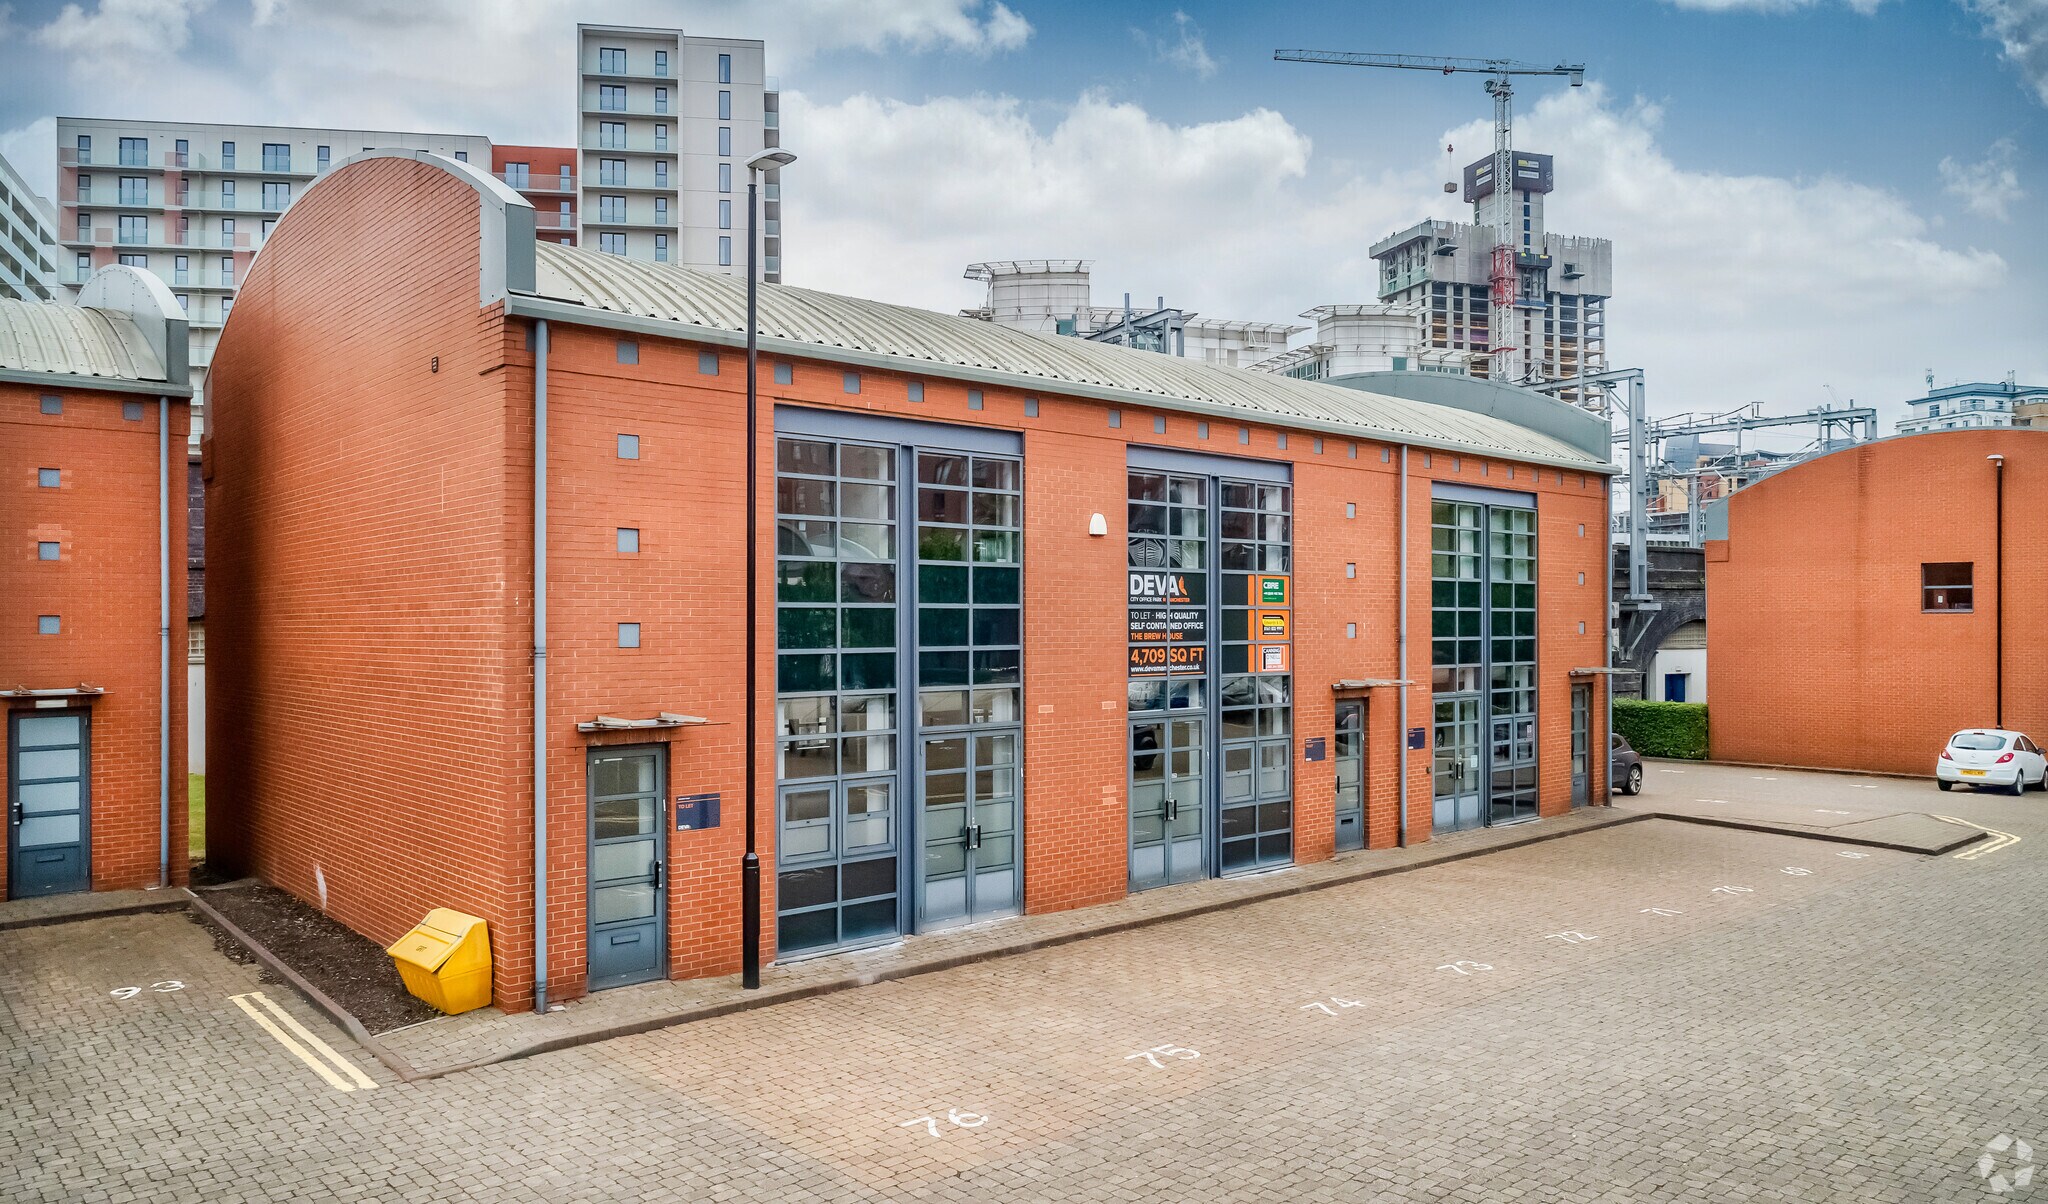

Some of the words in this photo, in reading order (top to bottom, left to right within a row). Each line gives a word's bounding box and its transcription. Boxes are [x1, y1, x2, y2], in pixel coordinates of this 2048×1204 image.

[1130, 574, 1179, 595] DEVA
[1131, 611, 1139, 620] TO
[1140, 612, 1150, 620] LET
[1173, 611, 1199, 620] QUALITY
[1131, 632, 1142, 640] THE
[1143, 632, 1161, 640] BREW
[1162, 632, 1183, 640] HOUSE
[1131, 648, 1166, 665] 4,709
[1170, 647, 1187, 663] SQ
[1190, 647, 1204, 661] FT
[1544, 931, 1598, 944] 72
[1435, 960, 1494, 976] 73
[1299, 997, 1366, 1016] 74
[1123, 1043, 1201, 1069] 75
[900, 1108, 989, 1138] 76
